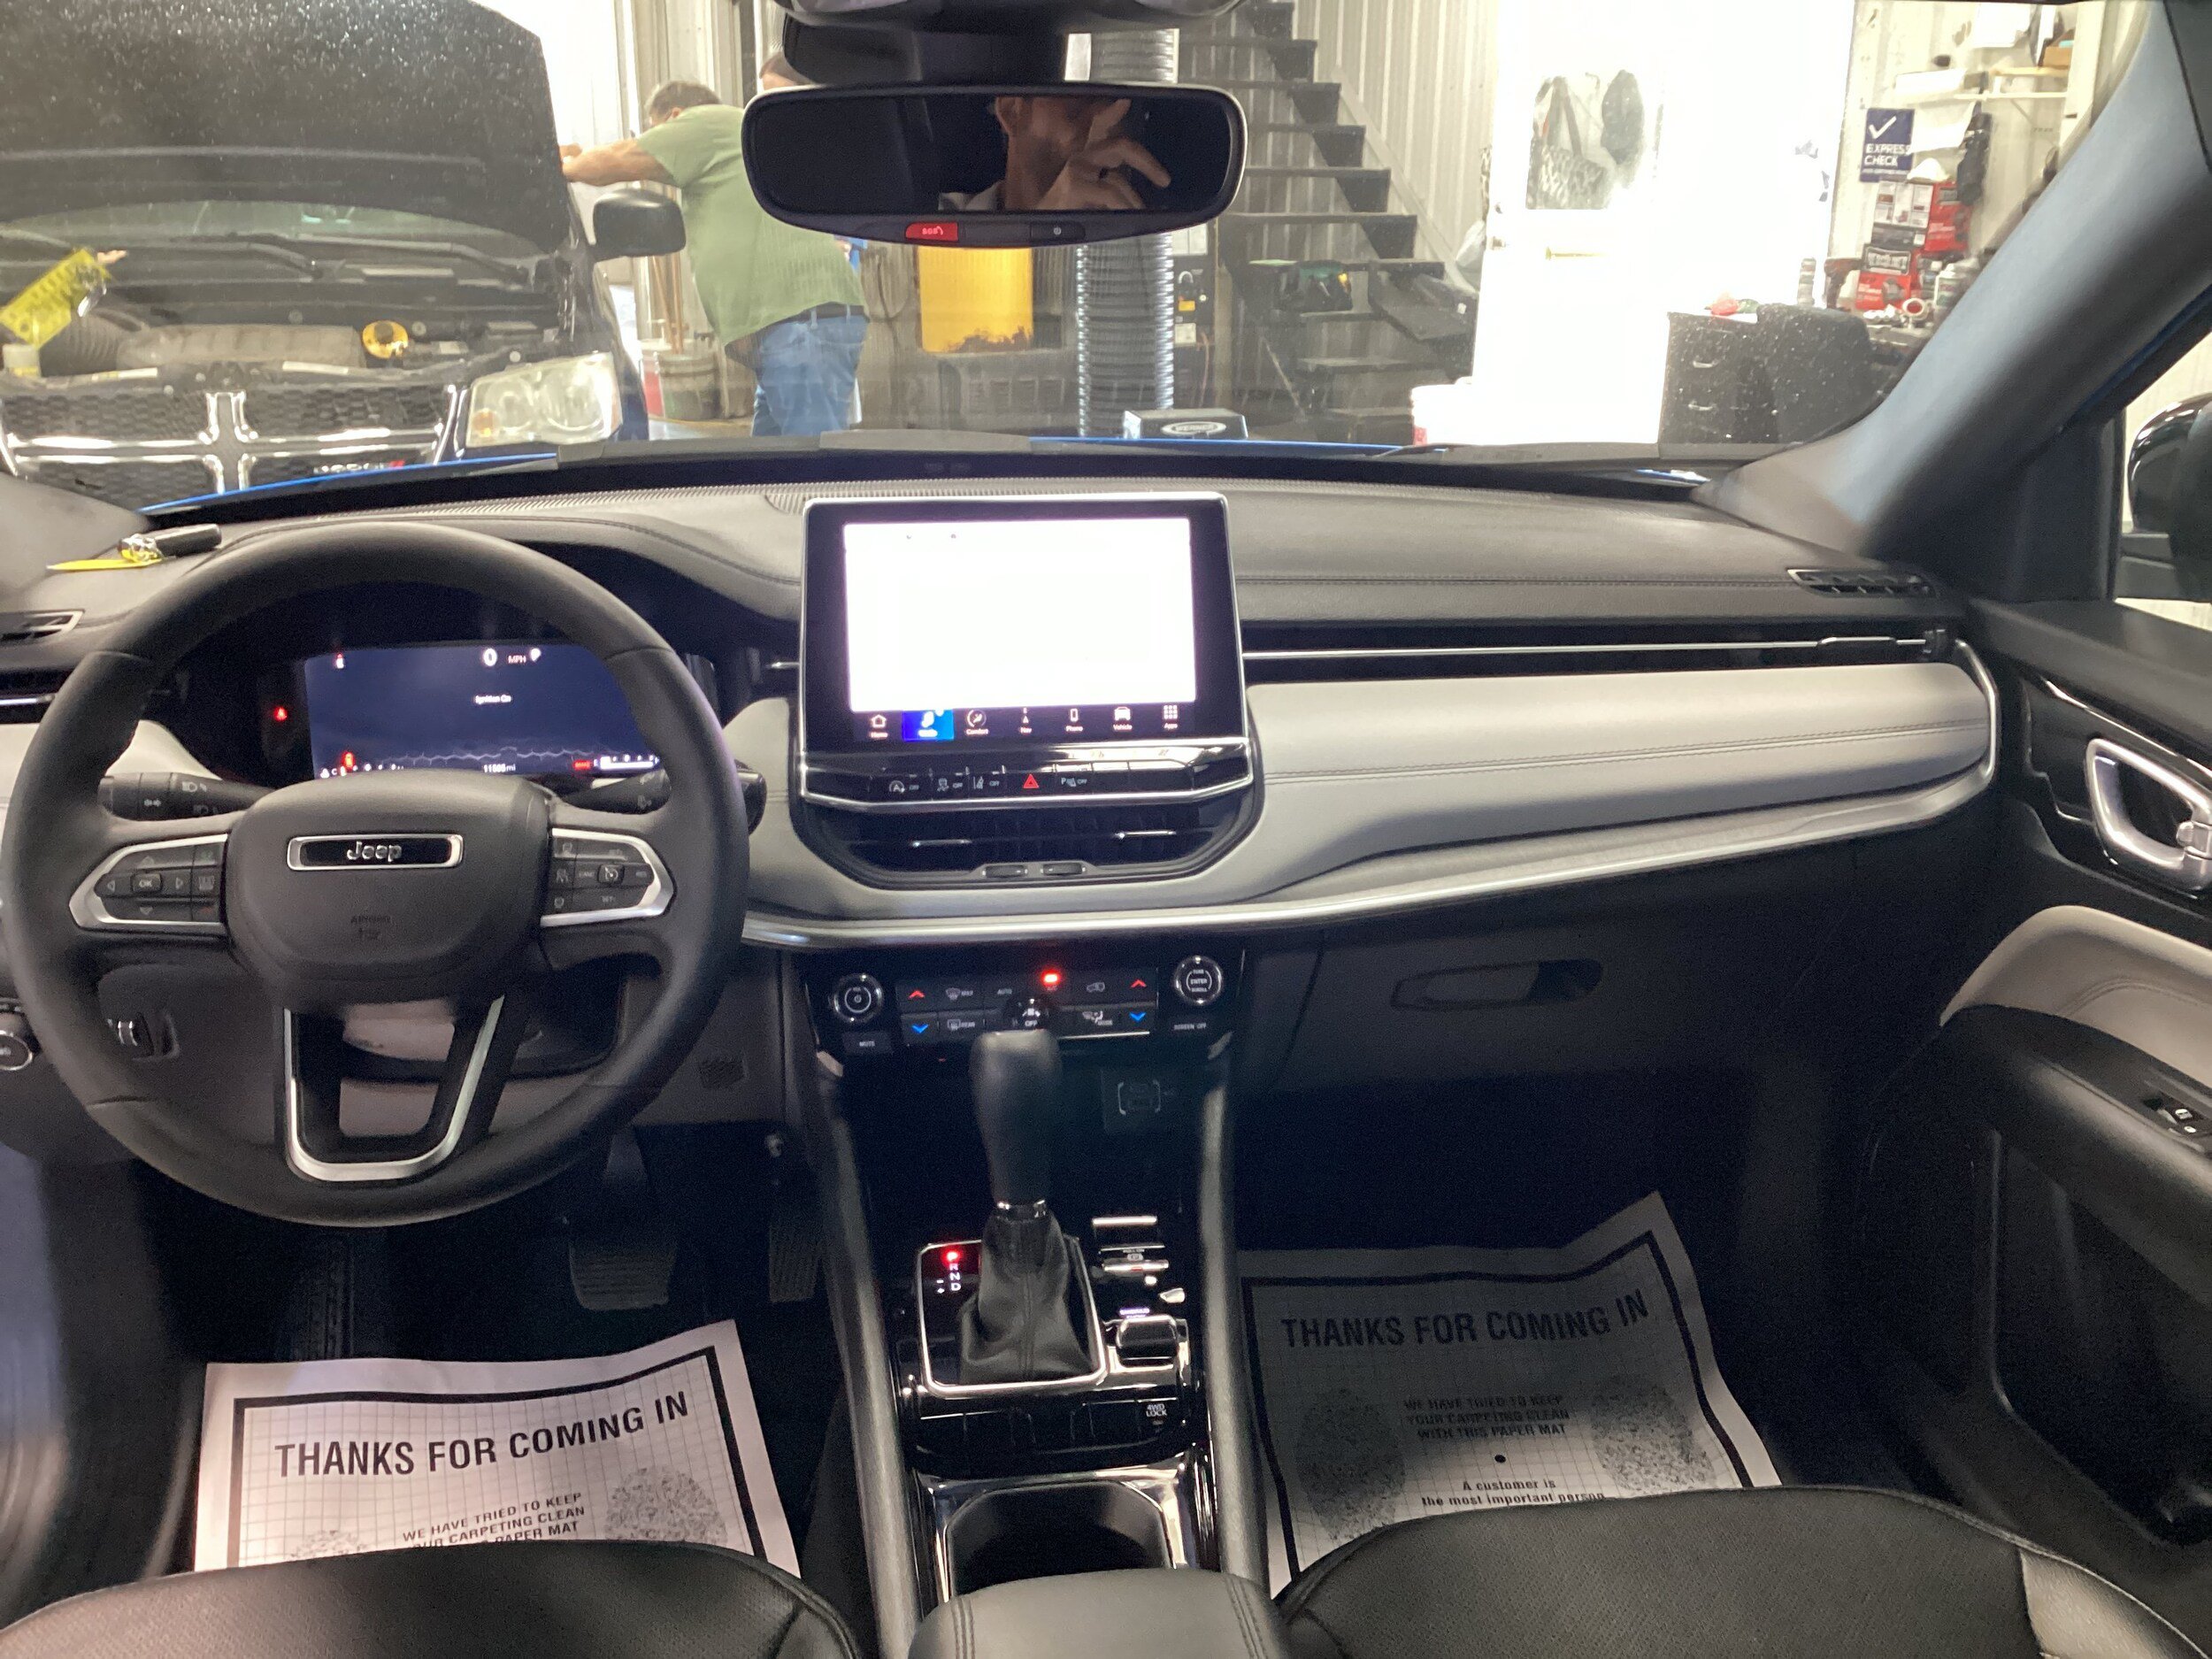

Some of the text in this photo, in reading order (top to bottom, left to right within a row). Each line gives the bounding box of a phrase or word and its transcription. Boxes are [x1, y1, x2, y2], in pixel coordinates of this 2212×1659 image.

[1864, 154, 1899, 167] CHECK
[483, 648, 497, 666] 0
[508, 655, 526, 664] MPH
[346, 841, 403, 863] Jeep
[949, 1271, 961, 1281] N
[950, 1282, 962, 1292] D
[1280, 1288, 1649, 1348] THANKS FOR COMING IN
[1526, 1409, 1571, 1421] CLEAN
[274, 1390, 688, 1478] THANKS FOR COMING IN
[1417, 1423, 1566, 1440] WITH THIS PAPER MAT
[1462, 1479, 1556, 1491] A customer is
[1421, 1496, 1444, 1507] the
[1448, 1494, 1482, 1506] most
[1486, 1493, 1555, 1507] important
[403, 1493, 582, 1542] WE HAVE TRIED TO KEEP
[449, 1516, 533, 1544] CARPETING
[537, 1507, 585, 1524] CLEAN
[548, 1521, 580, 1536] MAT
